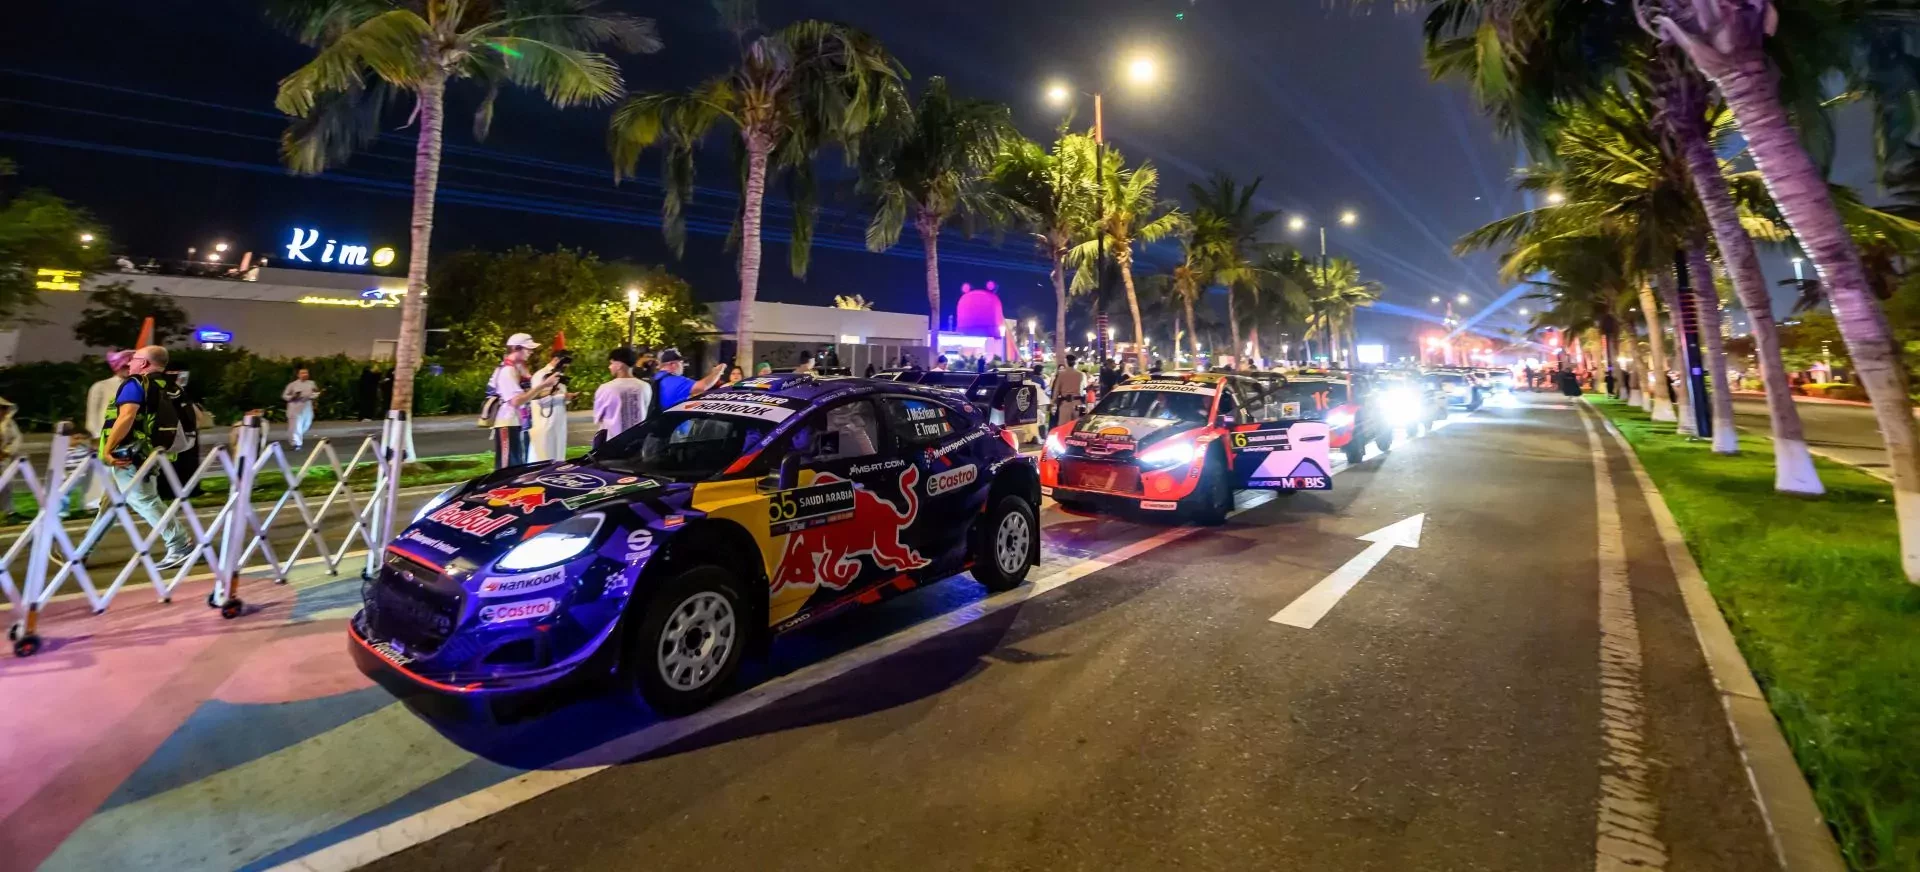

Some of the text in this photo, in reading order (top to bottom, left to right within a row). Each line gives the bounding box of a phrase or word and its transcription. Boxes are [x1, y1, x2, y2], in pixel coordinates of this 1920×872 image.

[695, 402, 774, 416] HANKOOK
[906, 408, 912, 422] J
[914, 423, 922, 436] E
[933, 430, 985, 459] Motorsport Ireland
[1235, 433, 1247, 448] 6
[938, 469, 975, 489] Castrol
[1281, 477, 1325, 489] MOBIS
[769, 490, 853, 523] 55 SAUDI ARABIA
[498, 571, 562, 591] HANKOOK
[496, 601, 551, 619] Castrol
[778, 613, 811, 631] FORD
